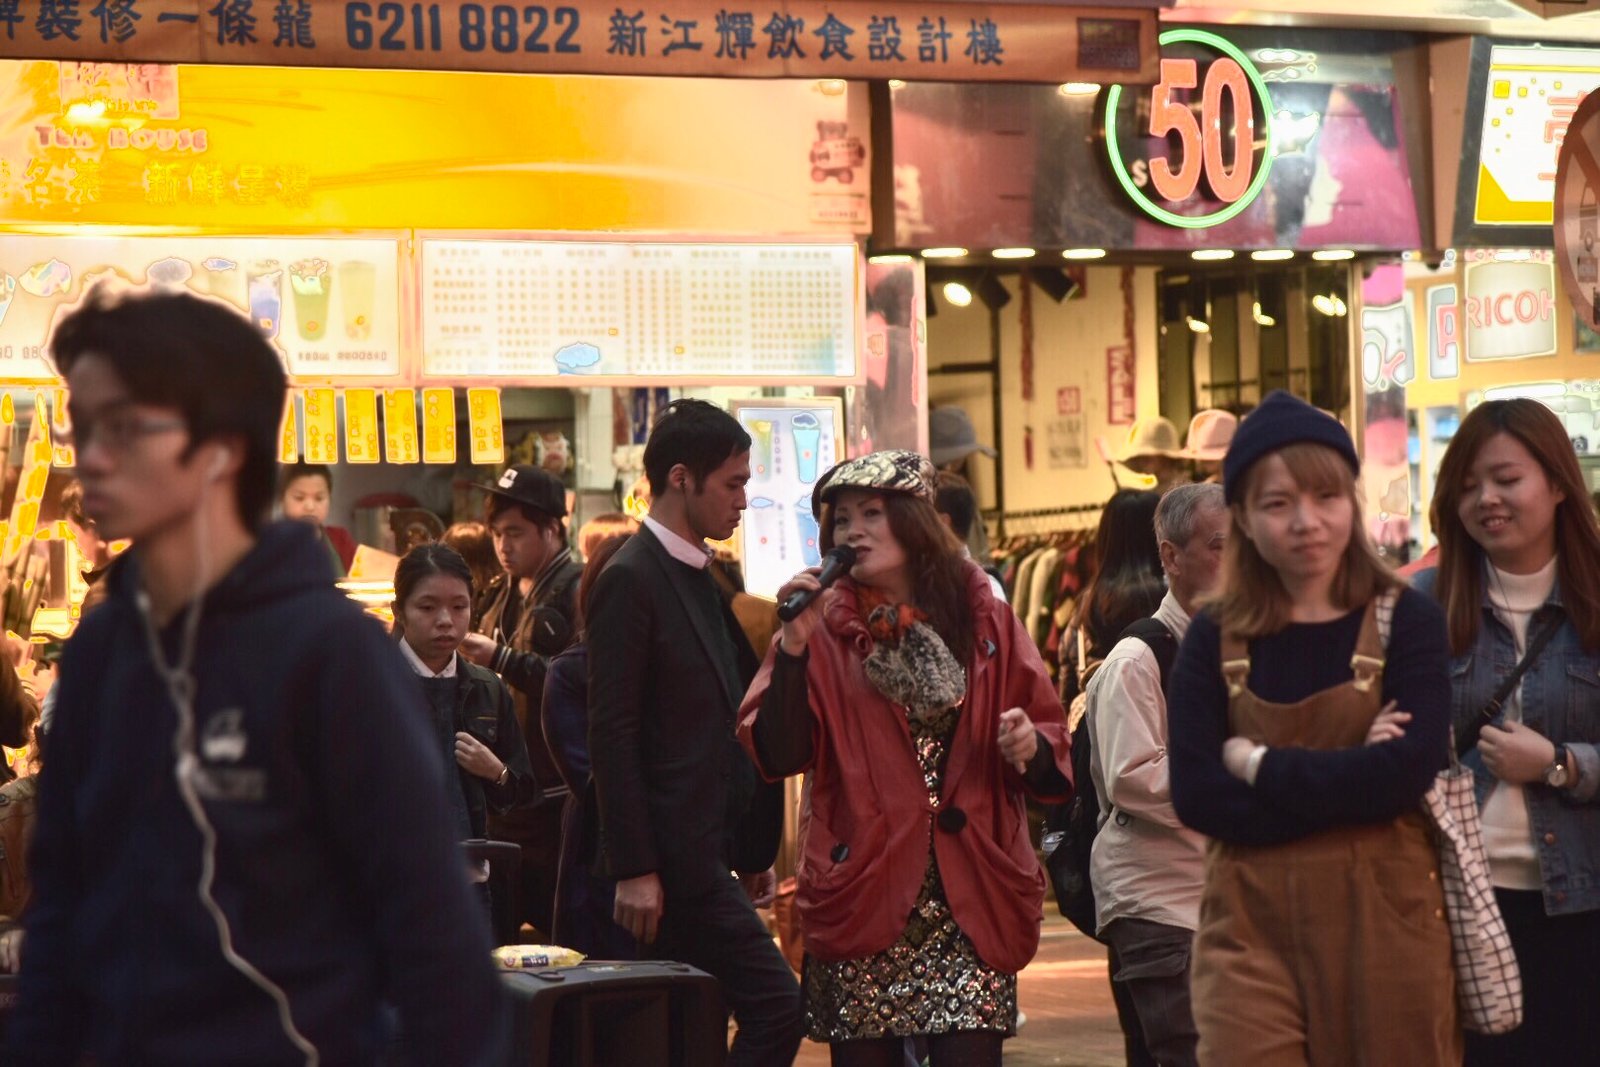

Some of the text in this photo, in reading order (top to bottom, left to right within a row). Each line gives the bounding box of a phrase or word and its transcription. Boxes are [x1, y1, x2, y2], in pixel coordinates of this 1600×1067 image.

[346, 2, 441, 50] 6211
[459, 4, 581, 53] 8822
[606, 8, 1003, 65] 新江輝飲食設計樓
[108, 127, 207, 151] HOUSE
